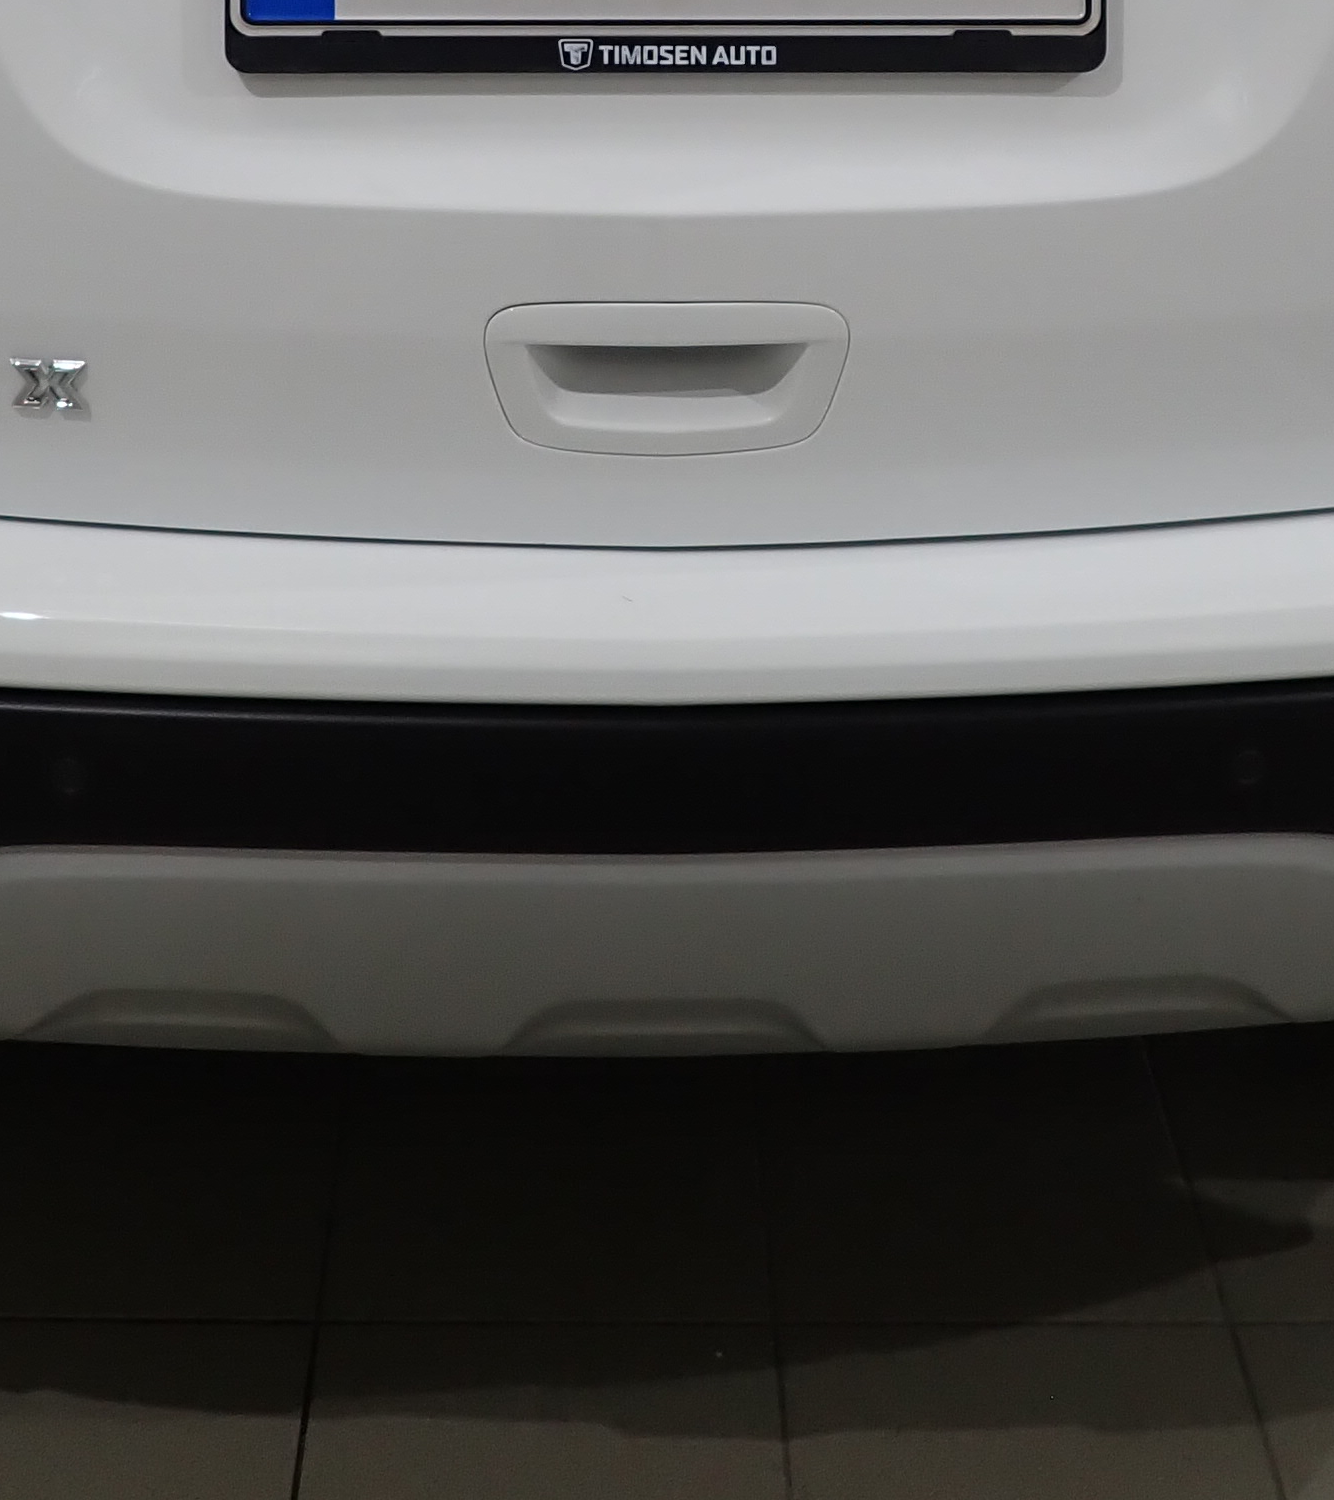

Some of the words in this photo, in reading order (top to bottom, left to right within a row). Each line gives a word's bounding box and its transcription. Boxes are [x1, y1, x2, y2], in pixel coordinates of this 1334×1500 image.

[598, 45, 708, 66] TIMOSEN
[711, 45, 778, 66] AUTO
[8, 356, 87, 412] X
